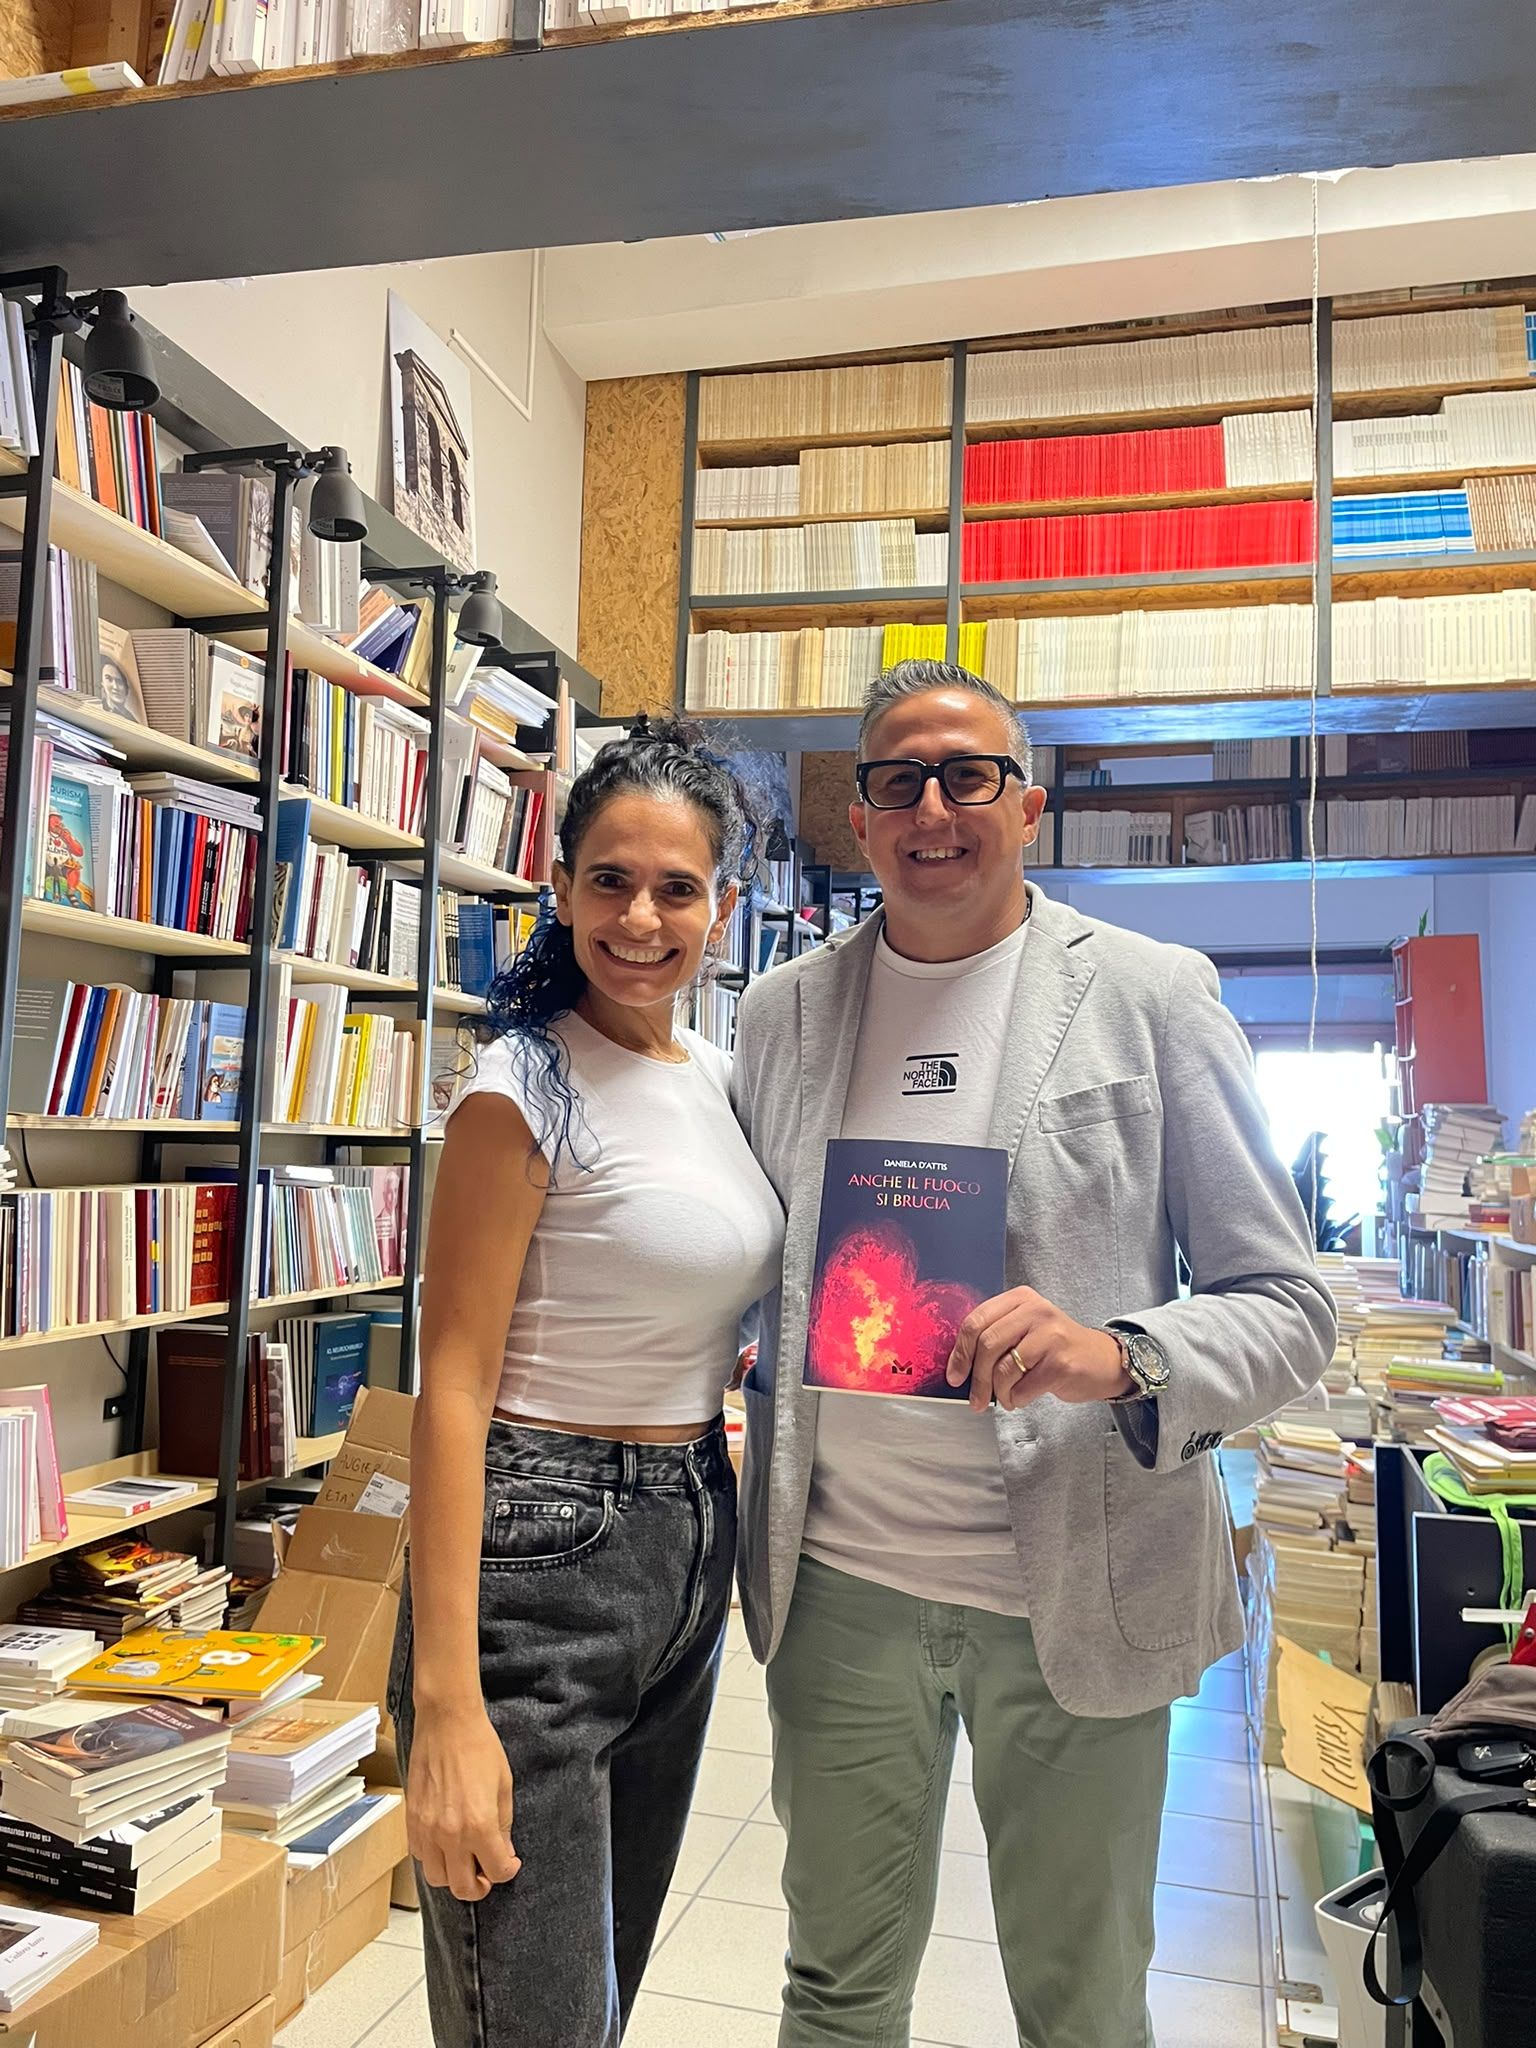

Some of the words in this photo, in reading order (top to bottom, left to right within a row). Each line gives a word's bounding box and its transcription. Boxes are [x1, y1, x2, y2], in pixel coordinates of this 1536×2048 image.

[920, 1060, 940, 1070] THE
[903, 1069, 939, 1080] NORTH
[912, 1078, 938, 1089] FACE
[884, 1159, 917, 1169] DANIELA
[918, 1161, 948, 1171] D'ATTIS
[847, 1173, 902, 1189] ANCHE
[907, 1176, 919, 1190] IL
[924, 1177, 981, 1195] FUOCO
[876, 1192, 888, 1207] SI
[893, 1193, 951, 1211] BRUCIA
